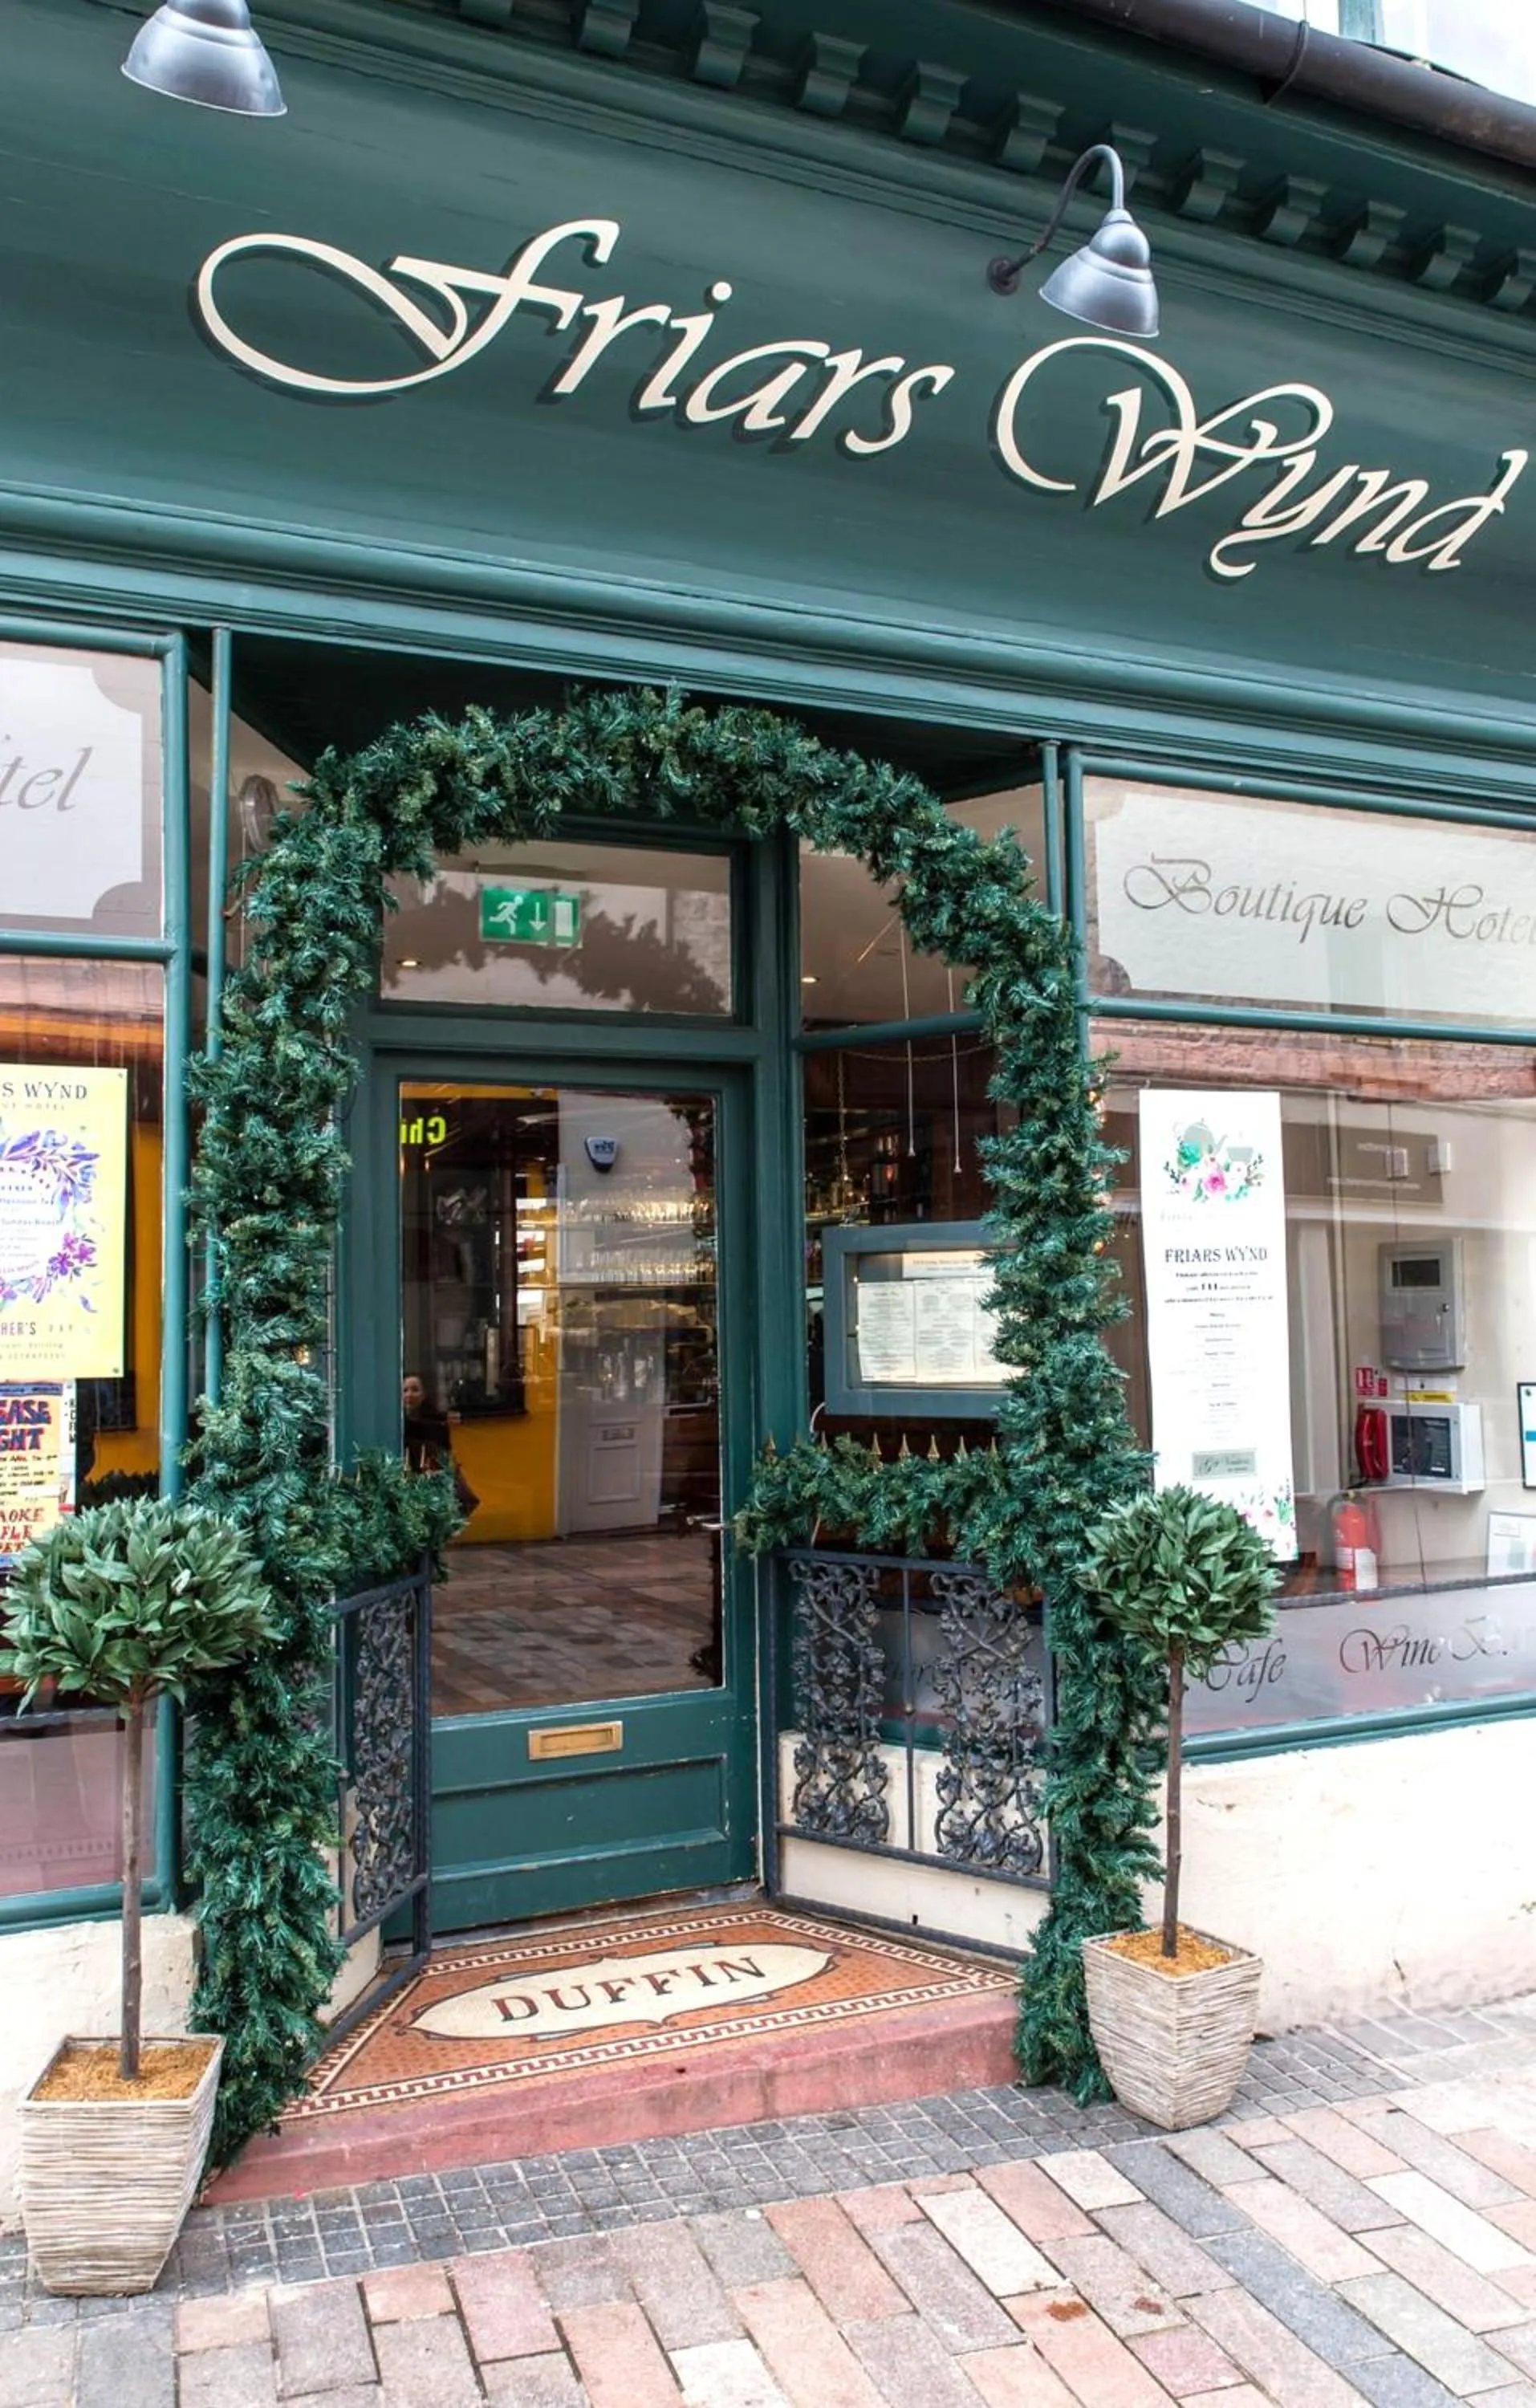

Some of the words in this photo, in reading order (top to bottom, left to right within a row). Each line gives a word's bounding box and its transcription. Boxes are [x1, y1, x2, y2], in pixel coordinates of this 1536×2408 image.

[197, 219, 955, 454] Friars
[997, 336, 1529, 577] Wynd
[1123, 852, 1368, 944] Boutique
[24, 1081, 88, 1100] WYND
[1164, 1248, 1222, 1263] FRIARS
[1225, 1246, 1269, 1263] WYND
[1, 1321, 37, 1336] HER'S
[1205, 1637, 1286, 1704] Cafe
[491, 1955, 767, 2023] DUFFIN
